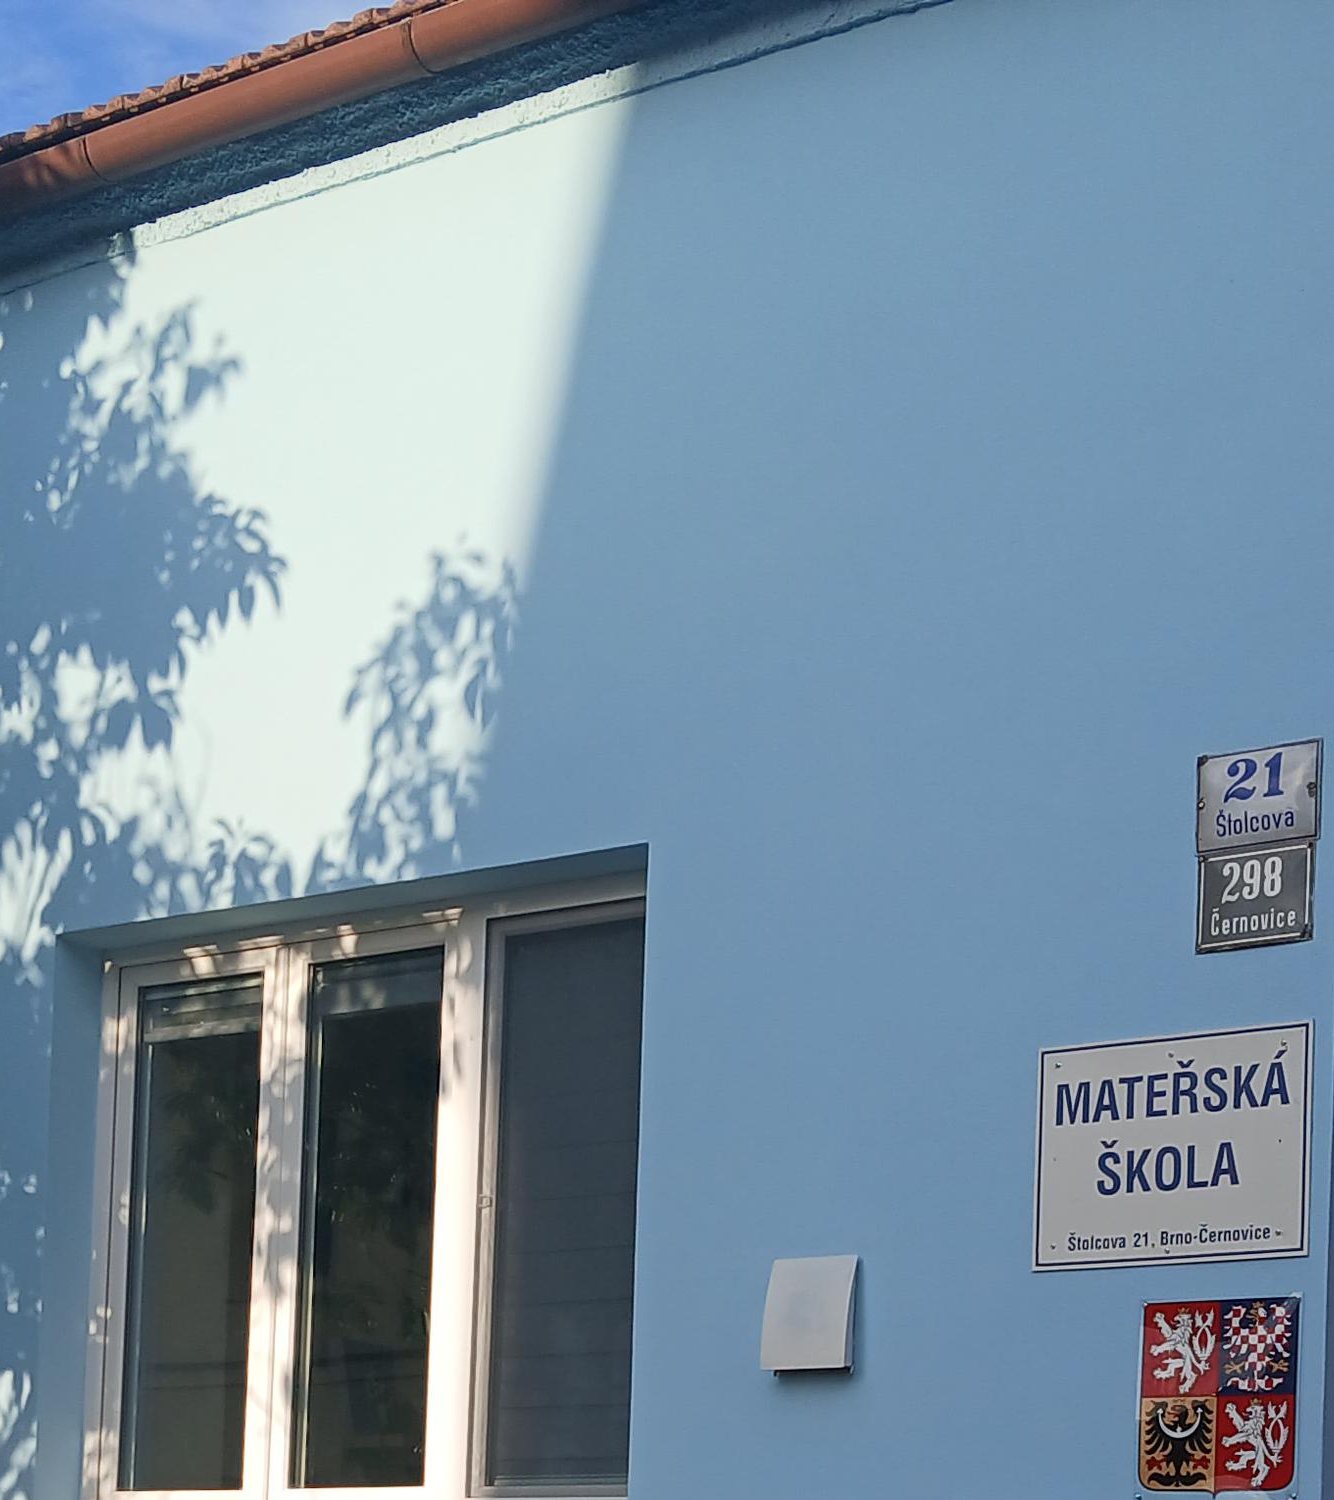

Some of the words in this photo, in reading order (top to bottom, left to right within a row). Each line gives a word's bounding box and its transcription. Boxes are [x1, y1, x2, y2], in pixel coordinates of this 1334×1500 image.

[1223, 752, 1284, 804] 21
[1216, 810, 1294, 838] Štolcova
[1222, 856, 1283, 904] 298
[1210, 908, 1296, 936] Černovice
[1055, 1049, 1291, 1127] MATEŘSKÁ
[1097, 1139, 1240, 1196] ŠKOLA
[1068, 1232, 1126, 1252] Štolcova
[1133, 1232, 1156, 1249] 21,
[1160, 1223, 1271, 1247] Brno-Černovice
